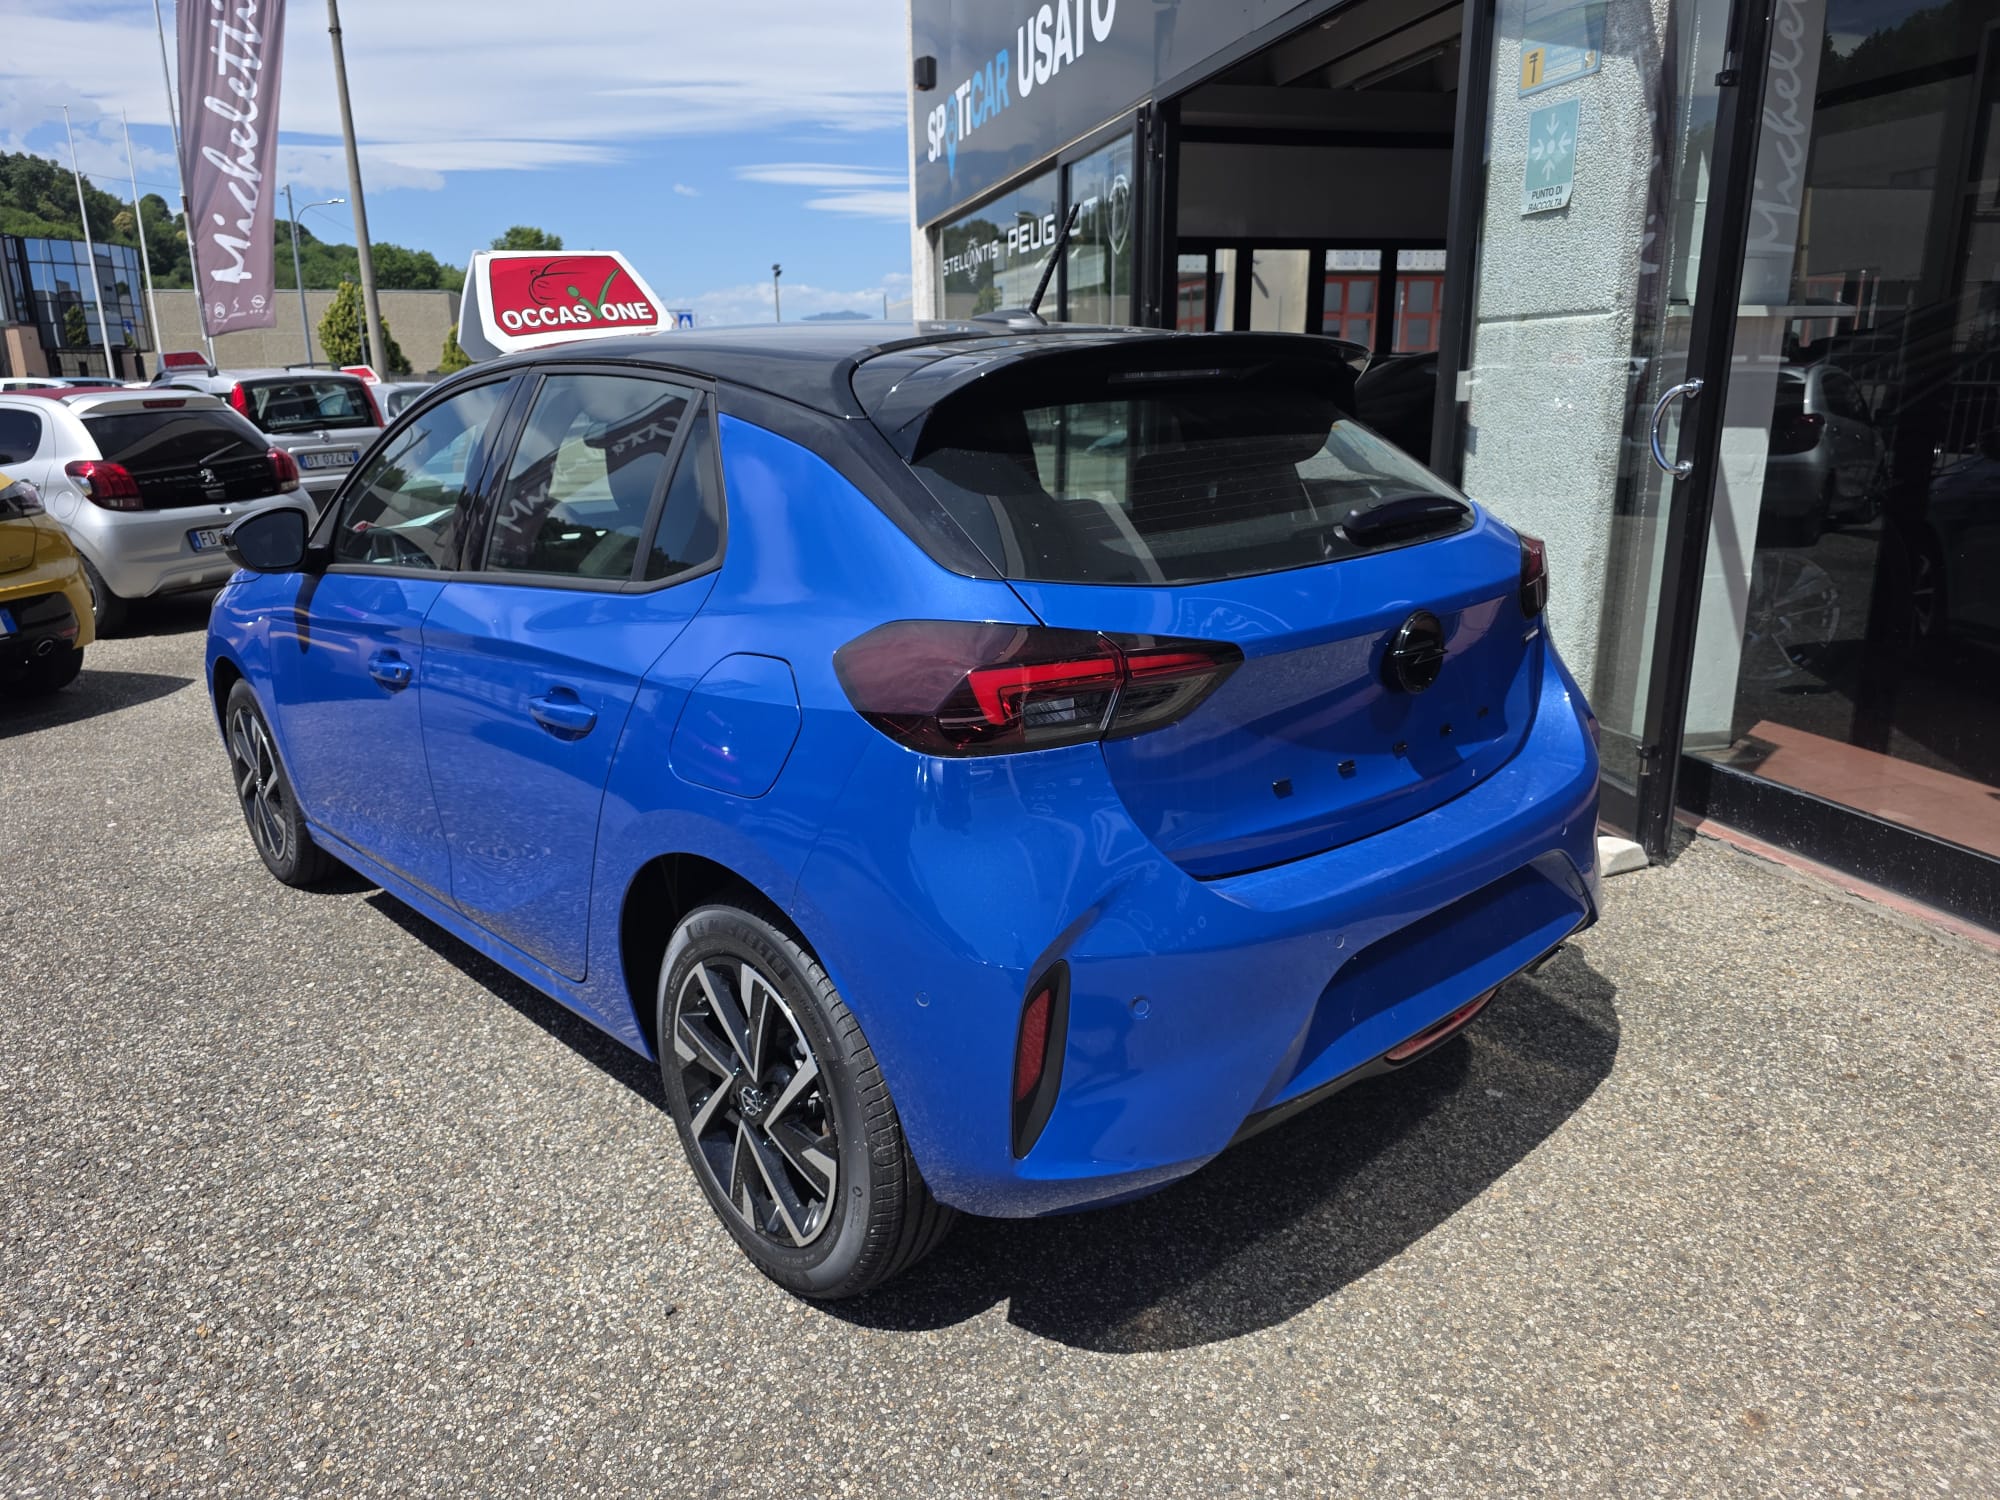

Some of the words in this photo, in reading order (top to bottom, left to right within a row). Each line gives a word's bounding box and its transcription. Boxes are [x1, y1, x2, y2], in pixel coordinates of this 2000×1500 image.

[1531, 187, 1554, 200] PUNTO
[1555, 185, 1563, 195] DI
[1527, 197, 1562, 212] RACCOLTA
[943, 239, 999, 277] STELLANTIS
